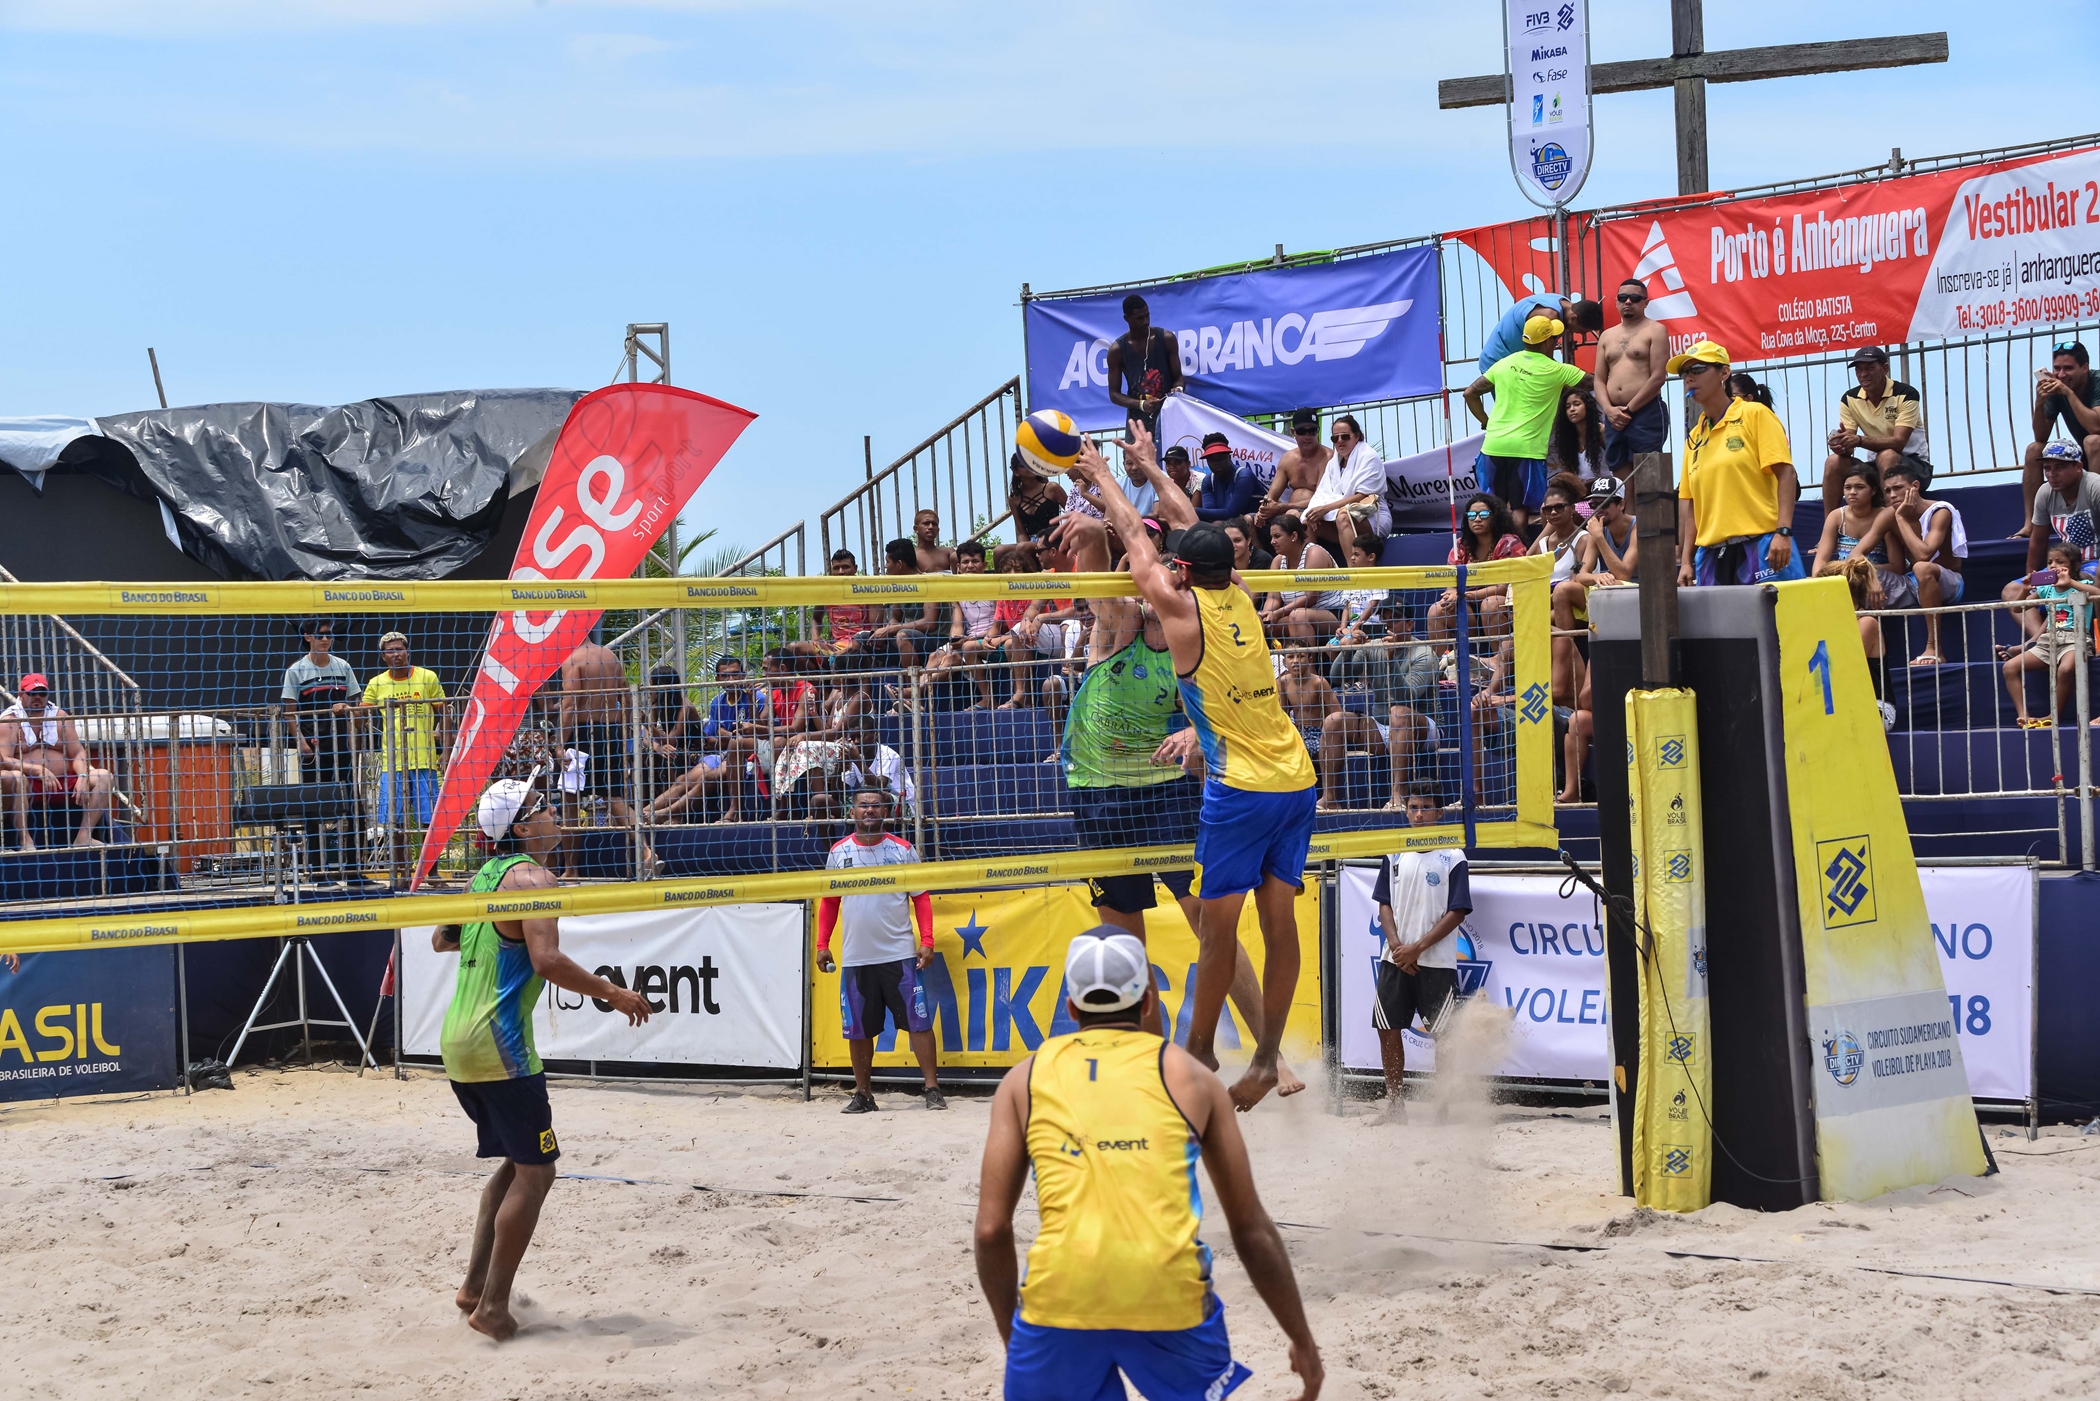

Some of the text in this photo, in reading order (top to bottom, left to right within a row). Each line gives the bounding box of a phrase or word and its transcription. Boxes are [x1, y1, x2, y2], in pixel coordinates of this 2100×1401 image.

[1526, 11, 1550, 27] FIVB
[1531, 45, 1567, 62] MIKASA
[1537, 161, 1568, 175] DIRECTV
[1964, 181, 2079, 241] Vestibular
[1711, 206, 1929, 285] Porto é Anhanguera
[1937, 266, 1999, 294] Inscreva-se
[2002, 262, 2012, 293] já
[1778, 295, 1853, 323] COLÉGIO BATISTA
[1956, 287, 2100, 330] Tel.:3018-3600/99909-36
[1761, 332, 1776, 349] Rua
[1776, 330, 1794, 347] Cova
[1794, 328, 1804, 345] da
[1830, 321, 1877, 342] 225-Centro
[1232, 447, 1274, 462] ABANA
[632, 496, 670, 541] sport
[687, 586, 758, 596] BANCO DO BRASIL
[852, 583, 919, 594] BANCO DO BRASIL
[1008, 580, 1071, 590] BANCO DO BRASIL
[122, 591, 208, 603] BANCO DO BRASIL
[324, 590, 404, 601] BANCO DO BRASIL
[512, 588, 588, 600] BANCO DO BRASIL
[1229, 622, 1246, 647] 2
[1808, 639, 1834, 716] 1
[1154, 687, 1168, 706] 2
[1253, 686, 1277, 699] event
[1406, 838, 1428, 847] BANCO
[1134, 854, 1194, 867] BANCO DO BRASIL
[986, 865, 1049, 878] BANCO DO BRASIL
[830, 876, 896, 890] BANCO DO BRASIL
[664, 888, 734, 902] BANCO DO BRASIL
[487, 900, 562, 914] BANCO DO BRASIL
[297, 912, 378, 927] BANCO DO BRASIL
[91, 926, 178, 941] BANCO DO BRASIL
[1473, 931, 1484, 950] 2018
[1509, 922, 1604, 957] CIRCU
[1947, 994, 1992, 1036] 18
[1408, 1035, 1424, 1048] CRUZ
[1867, 1020, 1952, 1050] CIRCUITO SUDAMERICANO
[1829, 1055, 1860, 1069] DIRCTV
[1872, 1056, 1905, 1078] VOLEIBOL
[1905, 1055, 1915, 1073] DE
[1915, 1051, 1937, 1072] PLAYA
[1936, 1048, 1952, 1068] 2018
[0, 1062, 121, 1081] BRASILEIRA DE VOLEIBOL
[1085, 1058, 1098, 1082] 1
[1097, 1137, 1149, 1151] event
